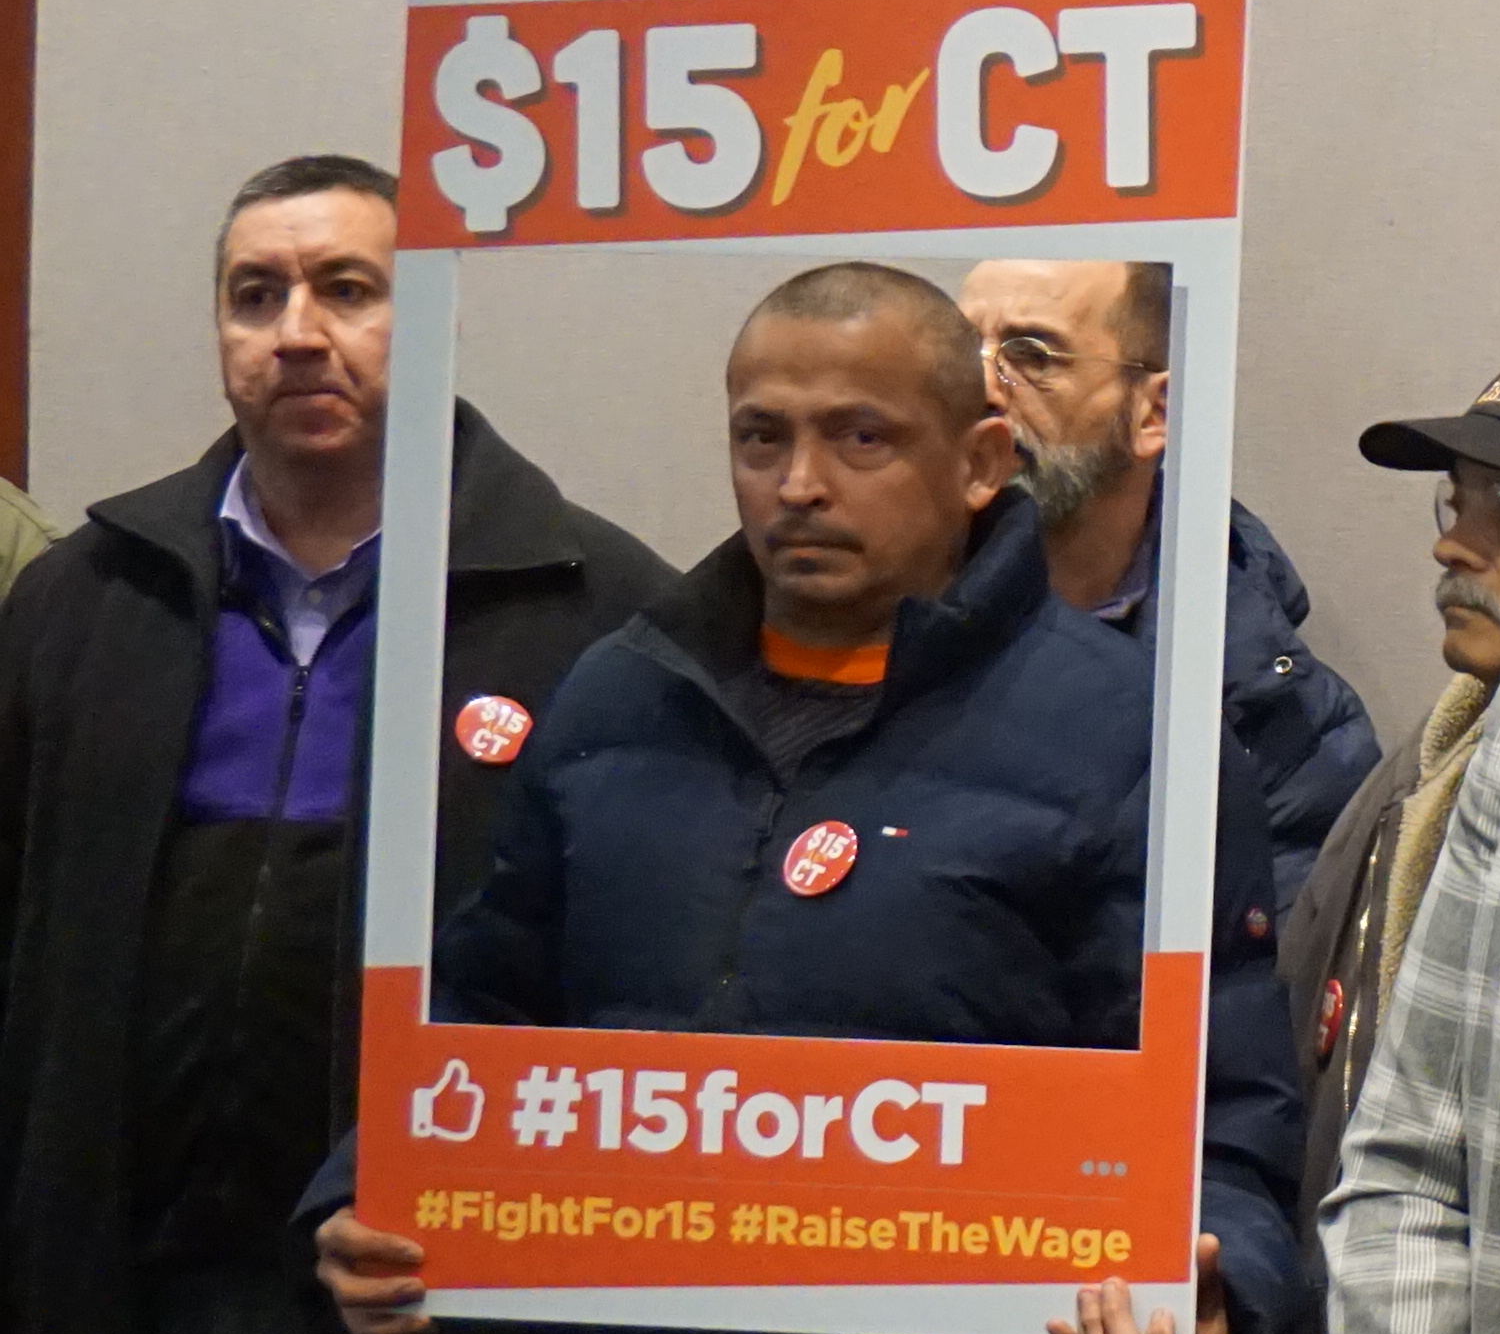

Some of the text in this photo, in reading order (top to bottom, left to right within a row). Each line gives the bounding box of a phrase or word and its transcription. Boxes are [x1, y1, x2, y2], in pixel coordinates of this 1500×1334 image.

[433, 3, 1198, 232] $15 for CT
[471, 727, 511, 756] CT
[807, 825, 851, 860] $15
[790, 858, 827, 887] CT
[512, 1066, 987, 1165] #15forCT
[415, 1190, 1134, 1269] #FightFor15 #RaiseTheWage
